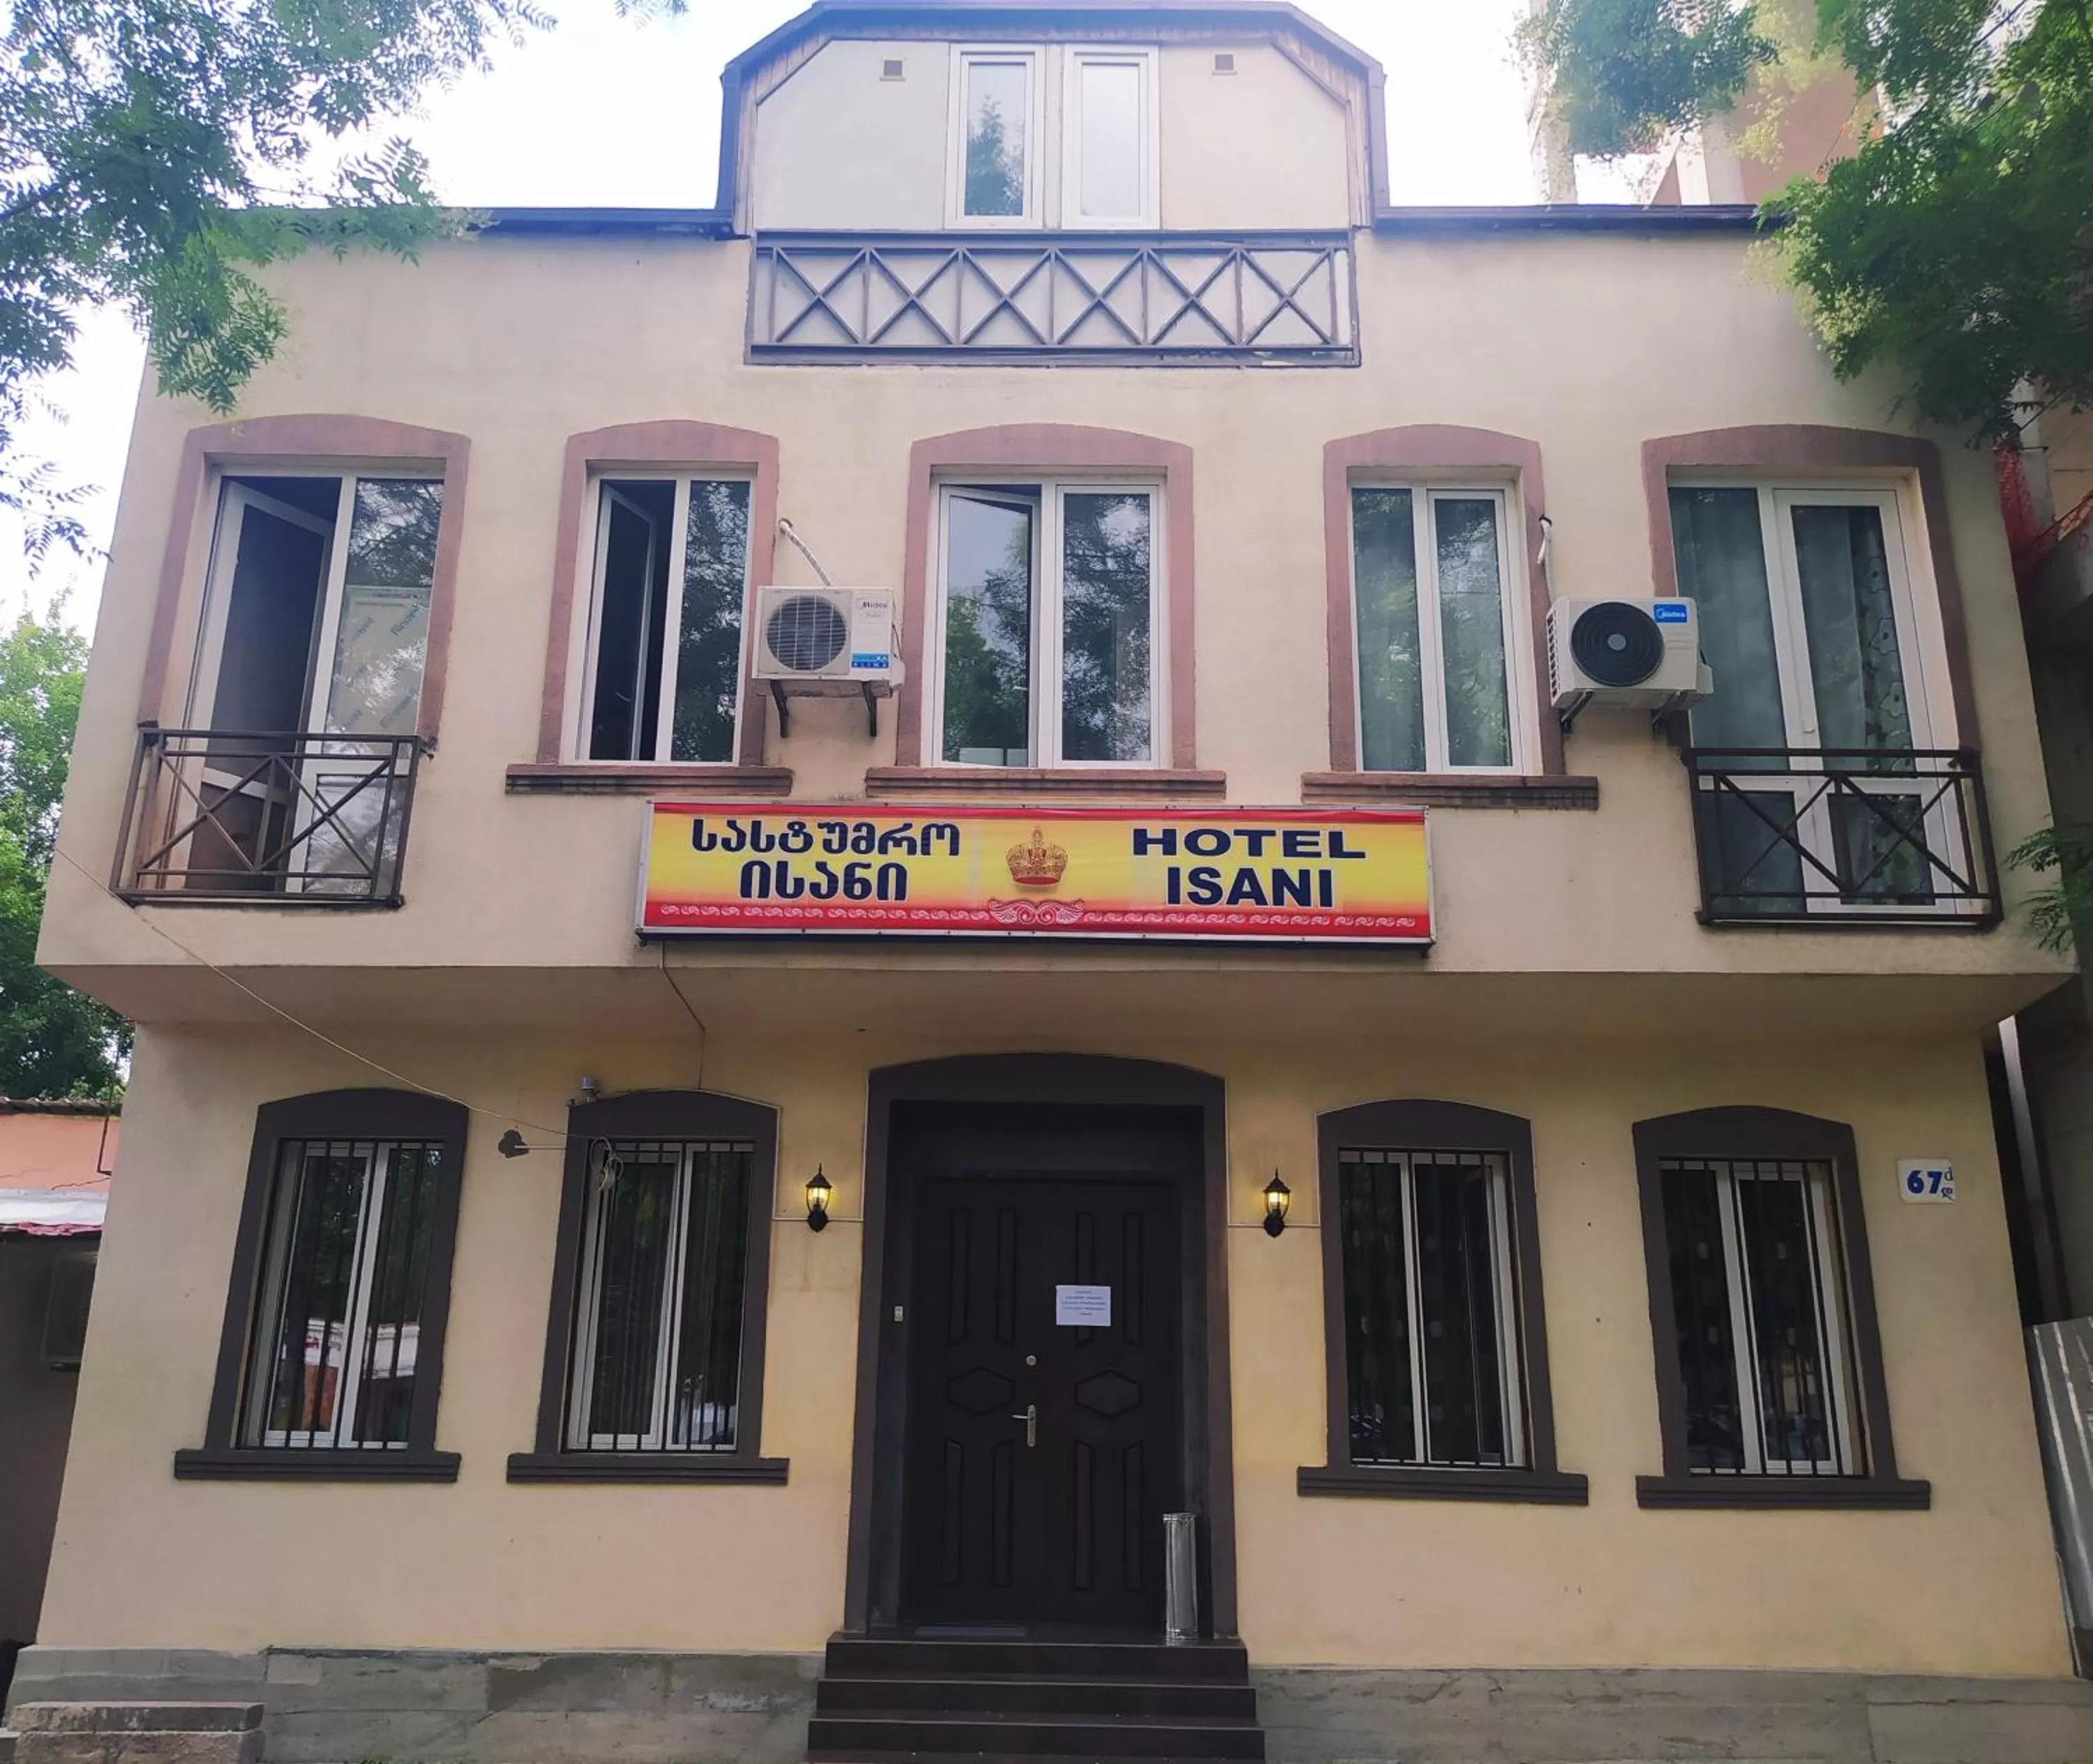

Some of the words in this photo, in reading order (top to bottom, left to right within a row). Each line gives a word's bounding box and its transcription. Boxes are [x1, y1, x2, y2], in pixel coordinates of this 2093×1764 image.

[692, 819, 960, 856] სასტუმრო
[1133, 828, 1366, 859] HOTEL
[740, 860, 907, 901] ისანი
[1168, 867, 1333, 908] ISANI
[1907, 1169, 1942, 1194] 67
